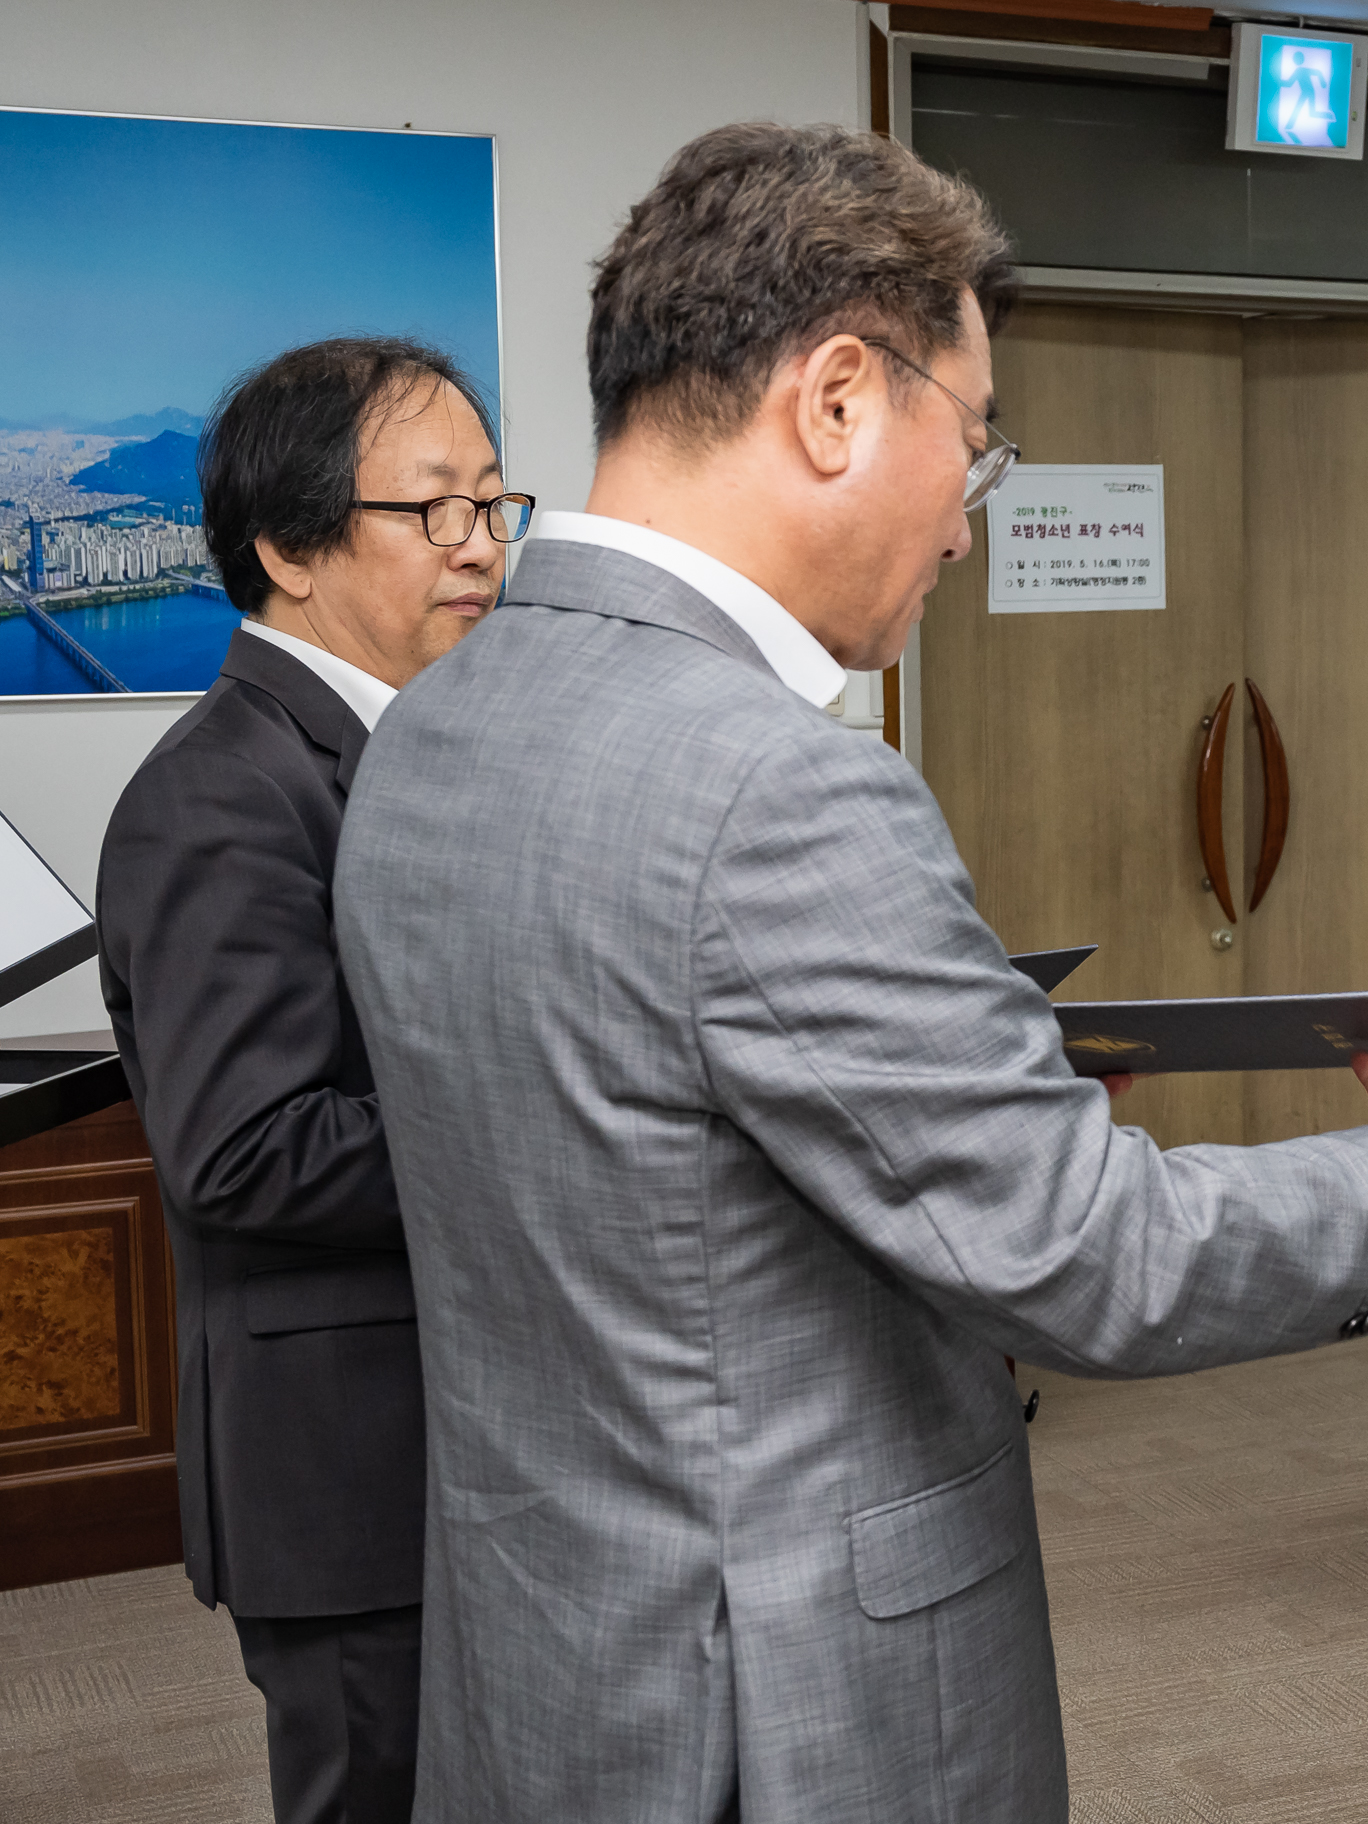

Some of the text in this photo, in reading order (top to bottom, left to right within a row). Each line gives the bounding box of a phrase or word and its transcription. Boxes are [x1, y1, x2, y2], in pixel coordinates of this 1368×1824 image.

[1010, 522, 1144, 539] 모범청소년 표창 수여식
